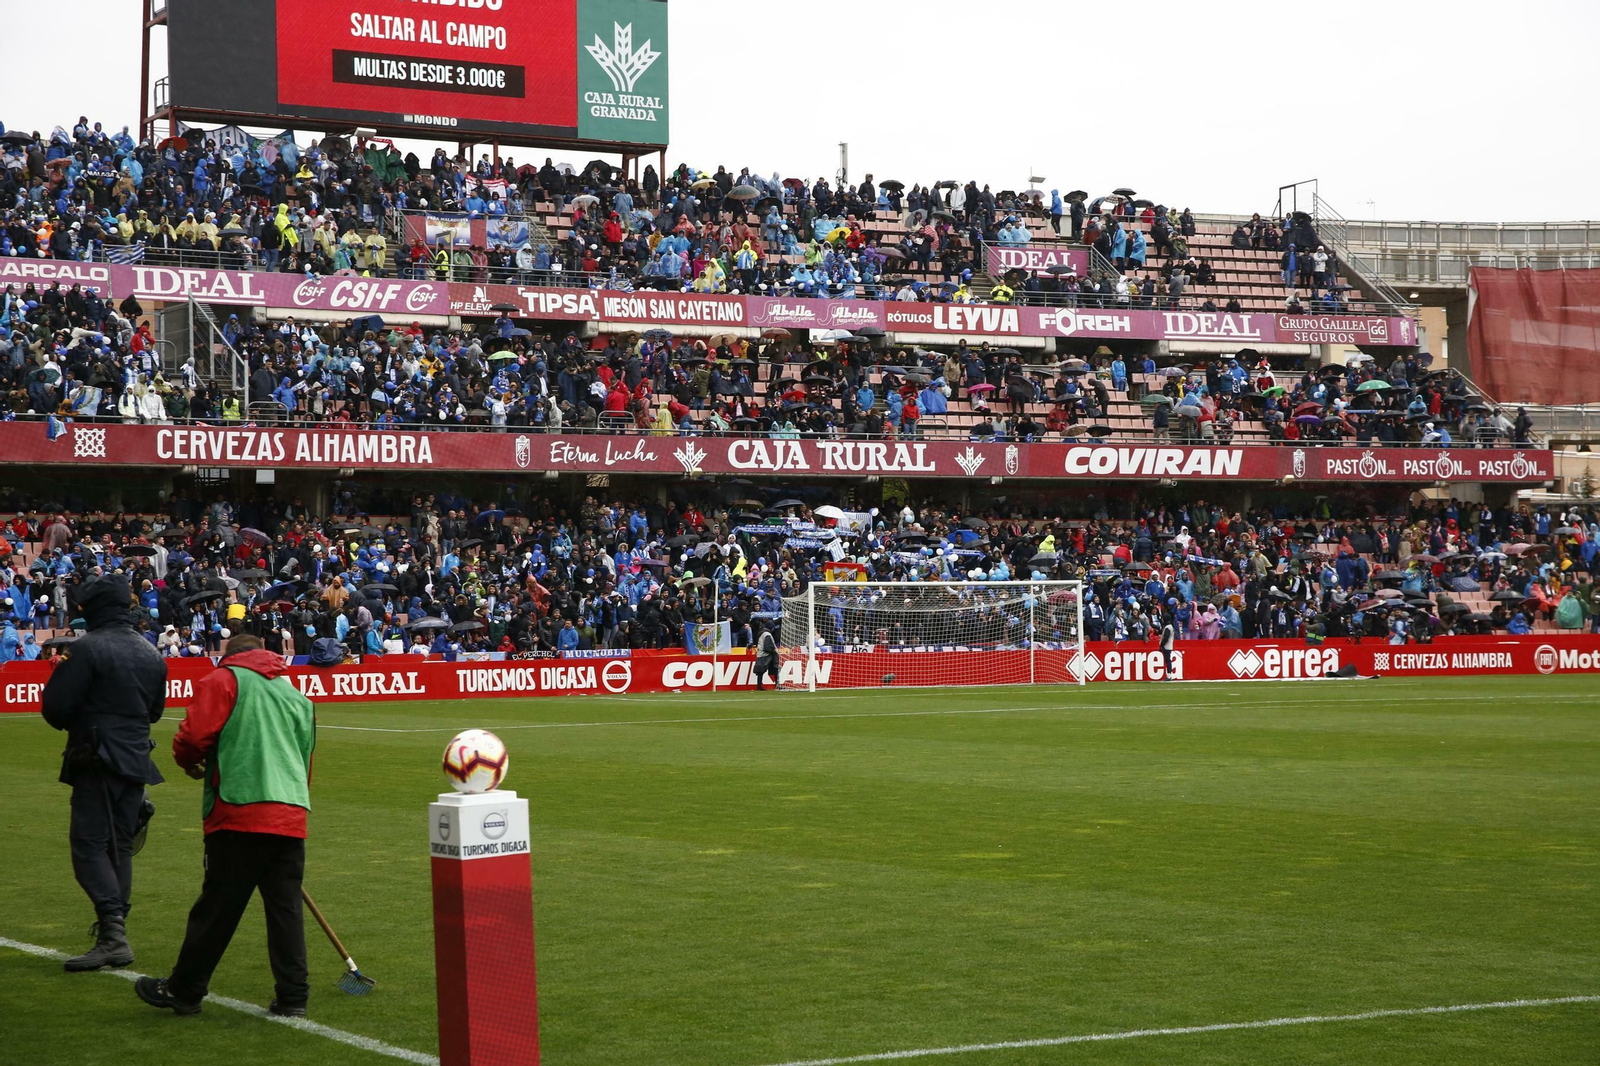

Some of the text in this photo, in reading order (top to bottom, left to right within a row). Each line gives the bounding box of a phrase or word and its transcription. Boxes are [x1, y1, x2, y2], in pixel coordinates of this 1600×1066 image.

[350, 12, 507, 50] SALTAR AL CAMPO
[354, 57, 506, 88] MULTAS DESDE 3.000€
[584, 92, 663, 109] CAJA RURAL
[414, 115, 457, 126] MONDO
[591, 106, 657, 121] GRANADA
[998, 250, 1077, 270] IDEAL
[0, 262, 109, 281] ARCALO
[132, 267, 265, 299] IDEAL
[450, 302, 463, 310] HP
[522, 292, 597, 314] TIPSA
[604, 294, 743, 322] MESÓN SAN CAYETANO
[887, 306, 1019, 332] RÓTULOS LEYVA
[1162, 312, 1261, 337] IDEAL
[1279, 317, 1366, 331] GRUPO GALILEA
[1294, 332, 1355, 343] SEGUROS
[1370, 325, 1385, 335] GG
[157, 429, 433, 464] CERVEZAS ALHAMBRA
[550, 438, 658, 465] Eterna Lucha
[728, 440, 936, 471] CAJA RURAL
[1065, 447, 1243, 475] COVIRAN
[523, 650, 555, 659] PERCHEL
[565, 650, 590, 658] MUY
[592, 648, 629, 657] NOBLE
[1393, 652, 1513, 670] CERVEZAS ALHAMBRA
[1540, 653, 1553, 666] FIAT
[332, 672, 425, 696] RURAL
[456, 666, 597, 692] TURISMOS DIGASA
[463, 840, 528, 856] TURISMOS DIGASA
